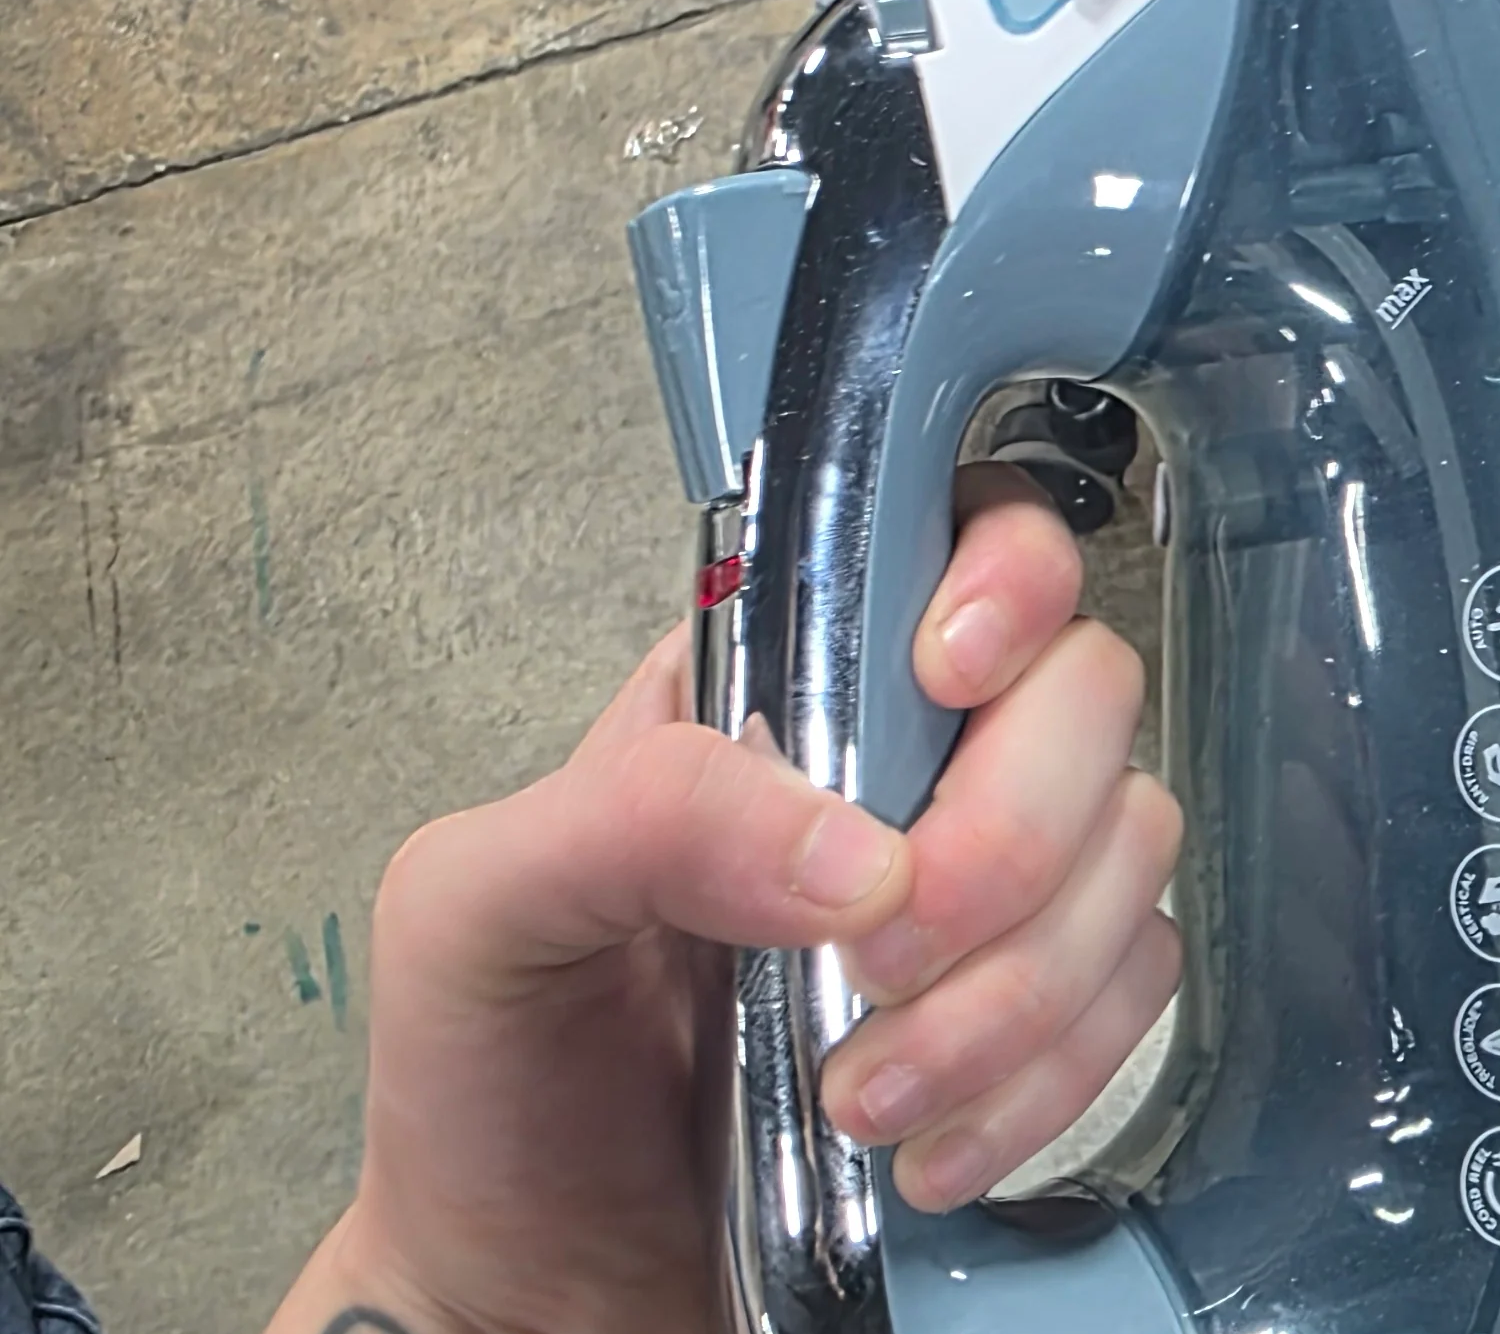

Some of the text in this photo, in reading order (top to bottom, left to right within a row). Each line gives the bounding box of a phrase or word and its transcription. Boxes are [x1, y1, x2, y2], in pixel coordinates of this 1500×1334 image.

[1375, 267, 1430, 324] max
[1471, 607, 1488, 649] AUTO
[1461, 730, 1490, 804] ANTI-DRIP
[1458, 872, 1484, 945] VERTICAL
[1468, 1147, 1498, 1231] CORD REEL
